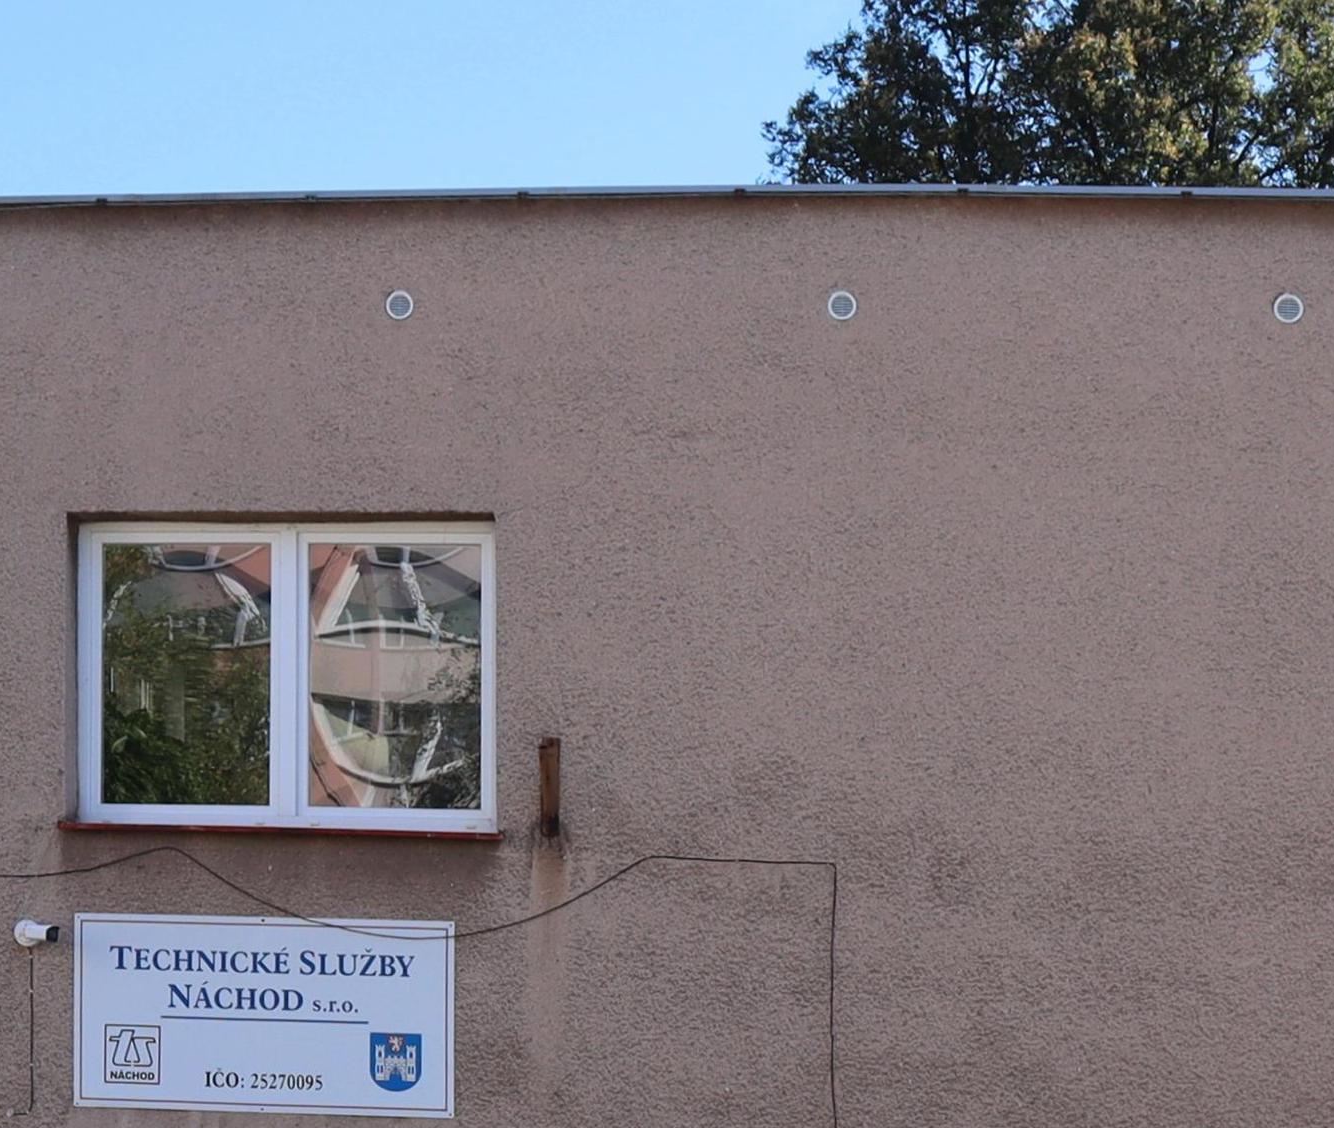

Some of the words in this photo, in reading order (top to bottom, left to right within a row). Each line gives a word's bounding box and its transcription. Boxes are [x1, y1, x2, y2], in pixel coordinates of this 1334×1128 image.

[109, 945, 290, 974] TECHNICKÉ
[299, 948, 415, 977] SLUŽBY
[167, 981, 305, 1012] NÁCHOD
[312, 998, 359, 1014] s.r.o.
[204, 1067, 245, 1089] IČO:
[250, 1072, 324, 1091] 25270095
